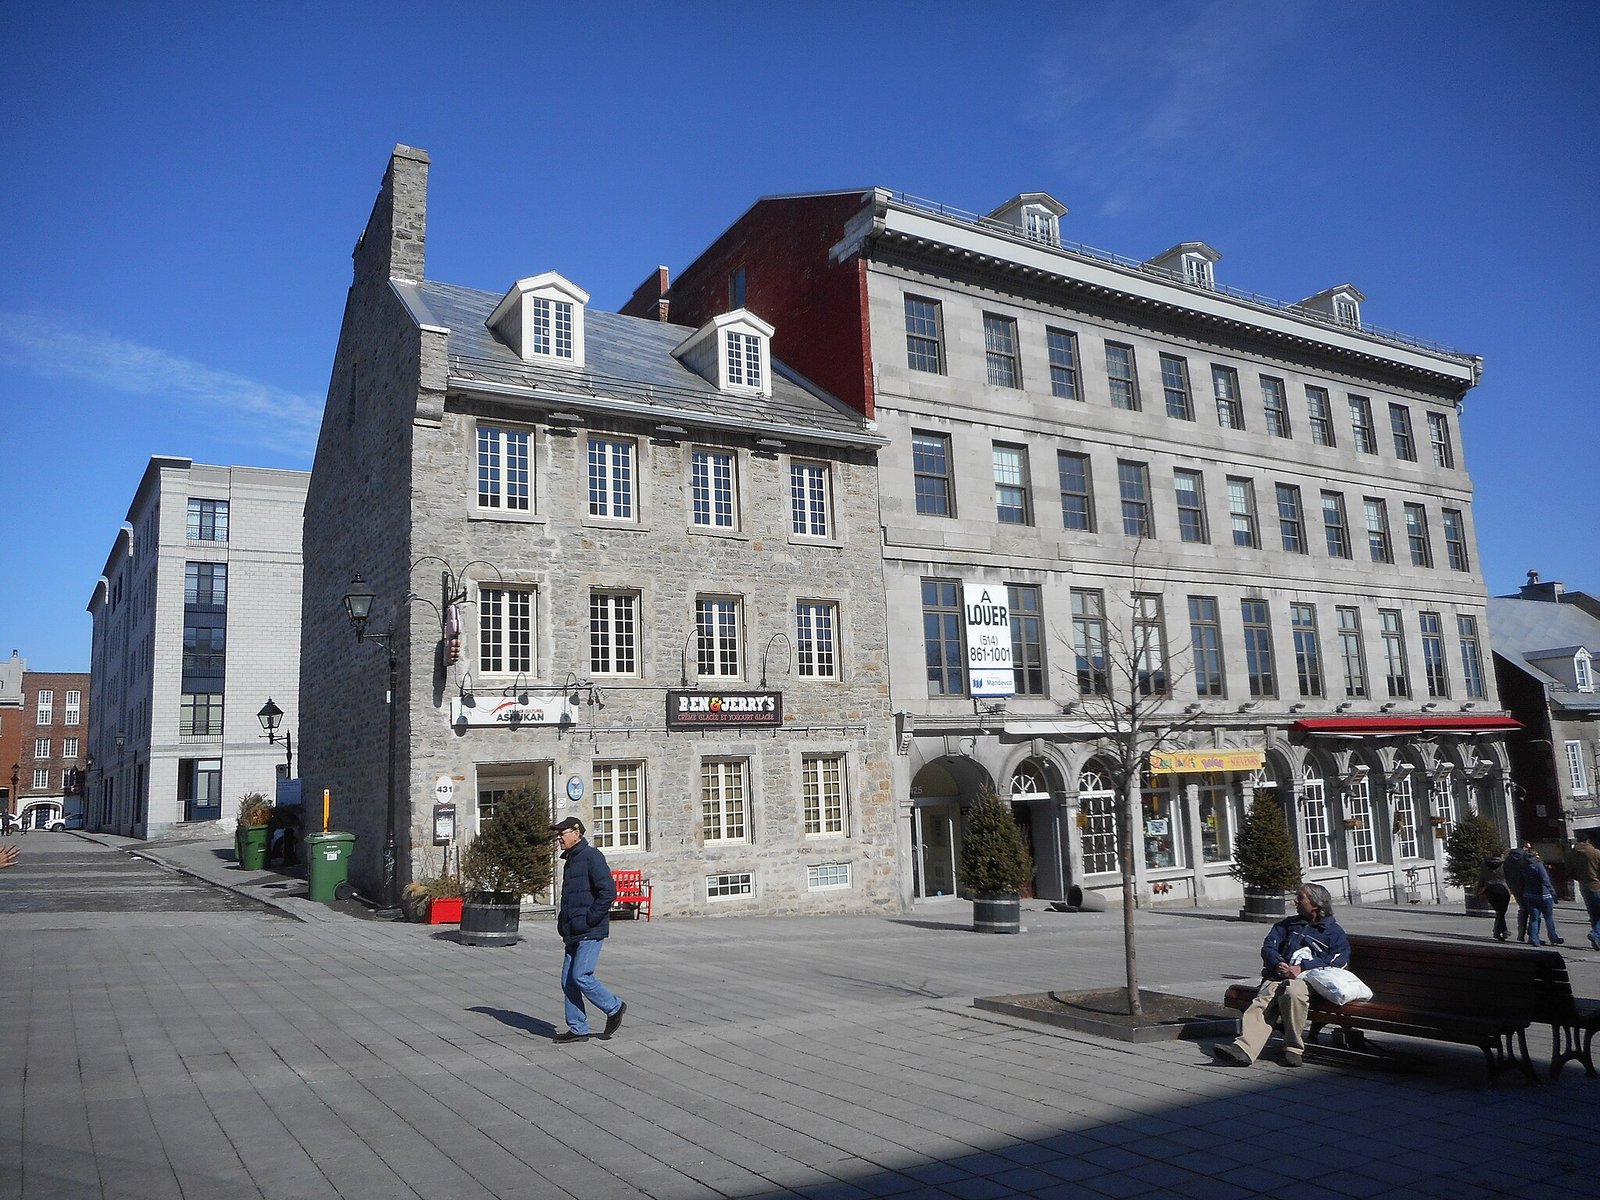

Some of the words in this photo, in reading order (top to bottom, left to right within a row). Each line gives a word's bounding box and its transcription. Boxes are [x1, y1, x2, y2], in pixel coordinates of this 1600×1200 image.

[967, 604, 1008, 626] LOUER
[980, 635, 998, 646] (514)
[970, 647, 1011, 662] 861-1001
[679, 696, 710, 712] BEN
[710, 697, 722, 712] &
[721, 695, 775, 712] JERRY'S
[437, 785, 453, 793] 431
